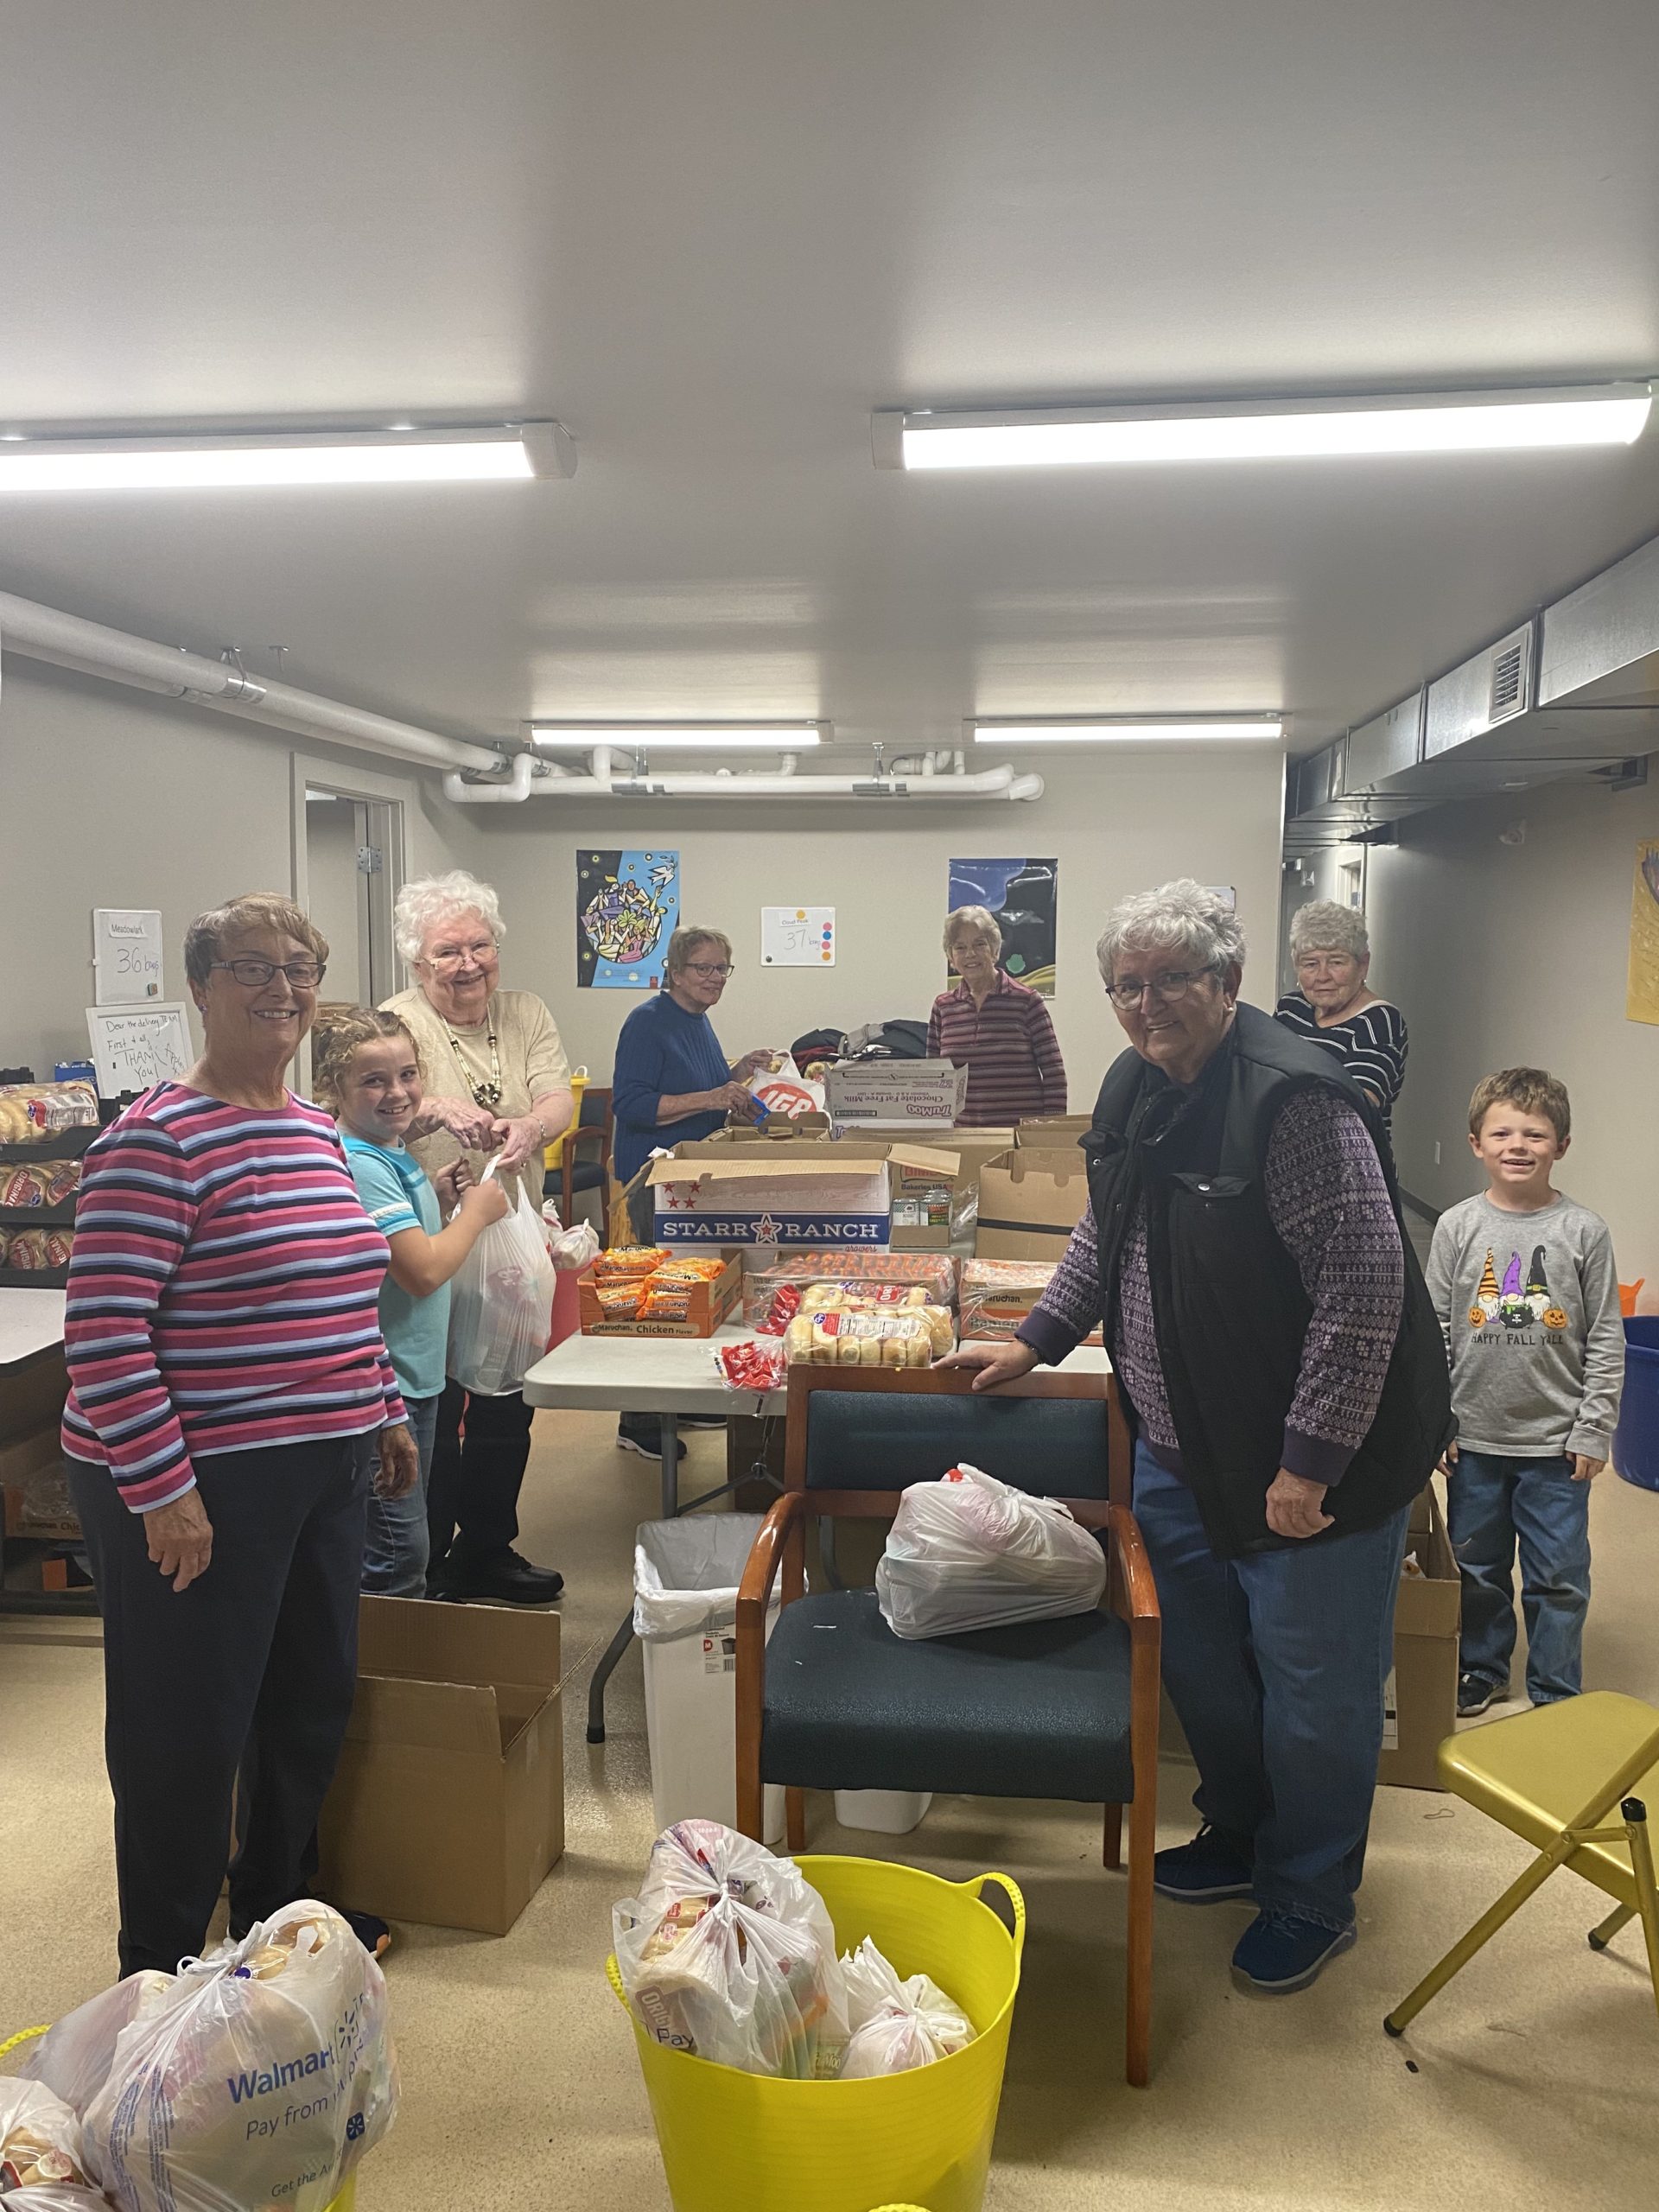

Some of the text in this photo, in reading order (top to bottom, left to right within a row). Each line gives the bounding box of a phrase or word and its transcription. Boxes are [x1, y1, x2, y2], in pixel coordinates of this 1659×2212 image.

[111, 924, 143, 934] Meadowlark
[784, 928, 806, 951] 37
[117, 947, 141, 974] 36
[105, 1020, 124, 1033] Dear
[107, 1037, 127, 1052] First
[899, 1094, 943, 1103] Chocolate
[906, 1103, 951, 1117] TruMoo
[664, 1222, 879, 1238] STARR RANCH
[636, 1325, 674, 1334] Chicken
[1471, 1332, 1501, 1345] HAPPY
[1506, 1333, 1535, 1345] FALL
[657, 2028, 696, 2049] Pay
[227, 2039, 335, 2104] Walmart
[246, 2097, 328, 2140] Pay from
[271, 2179, 294, 2198] Get
[297, 2170, 317, 2188] the
